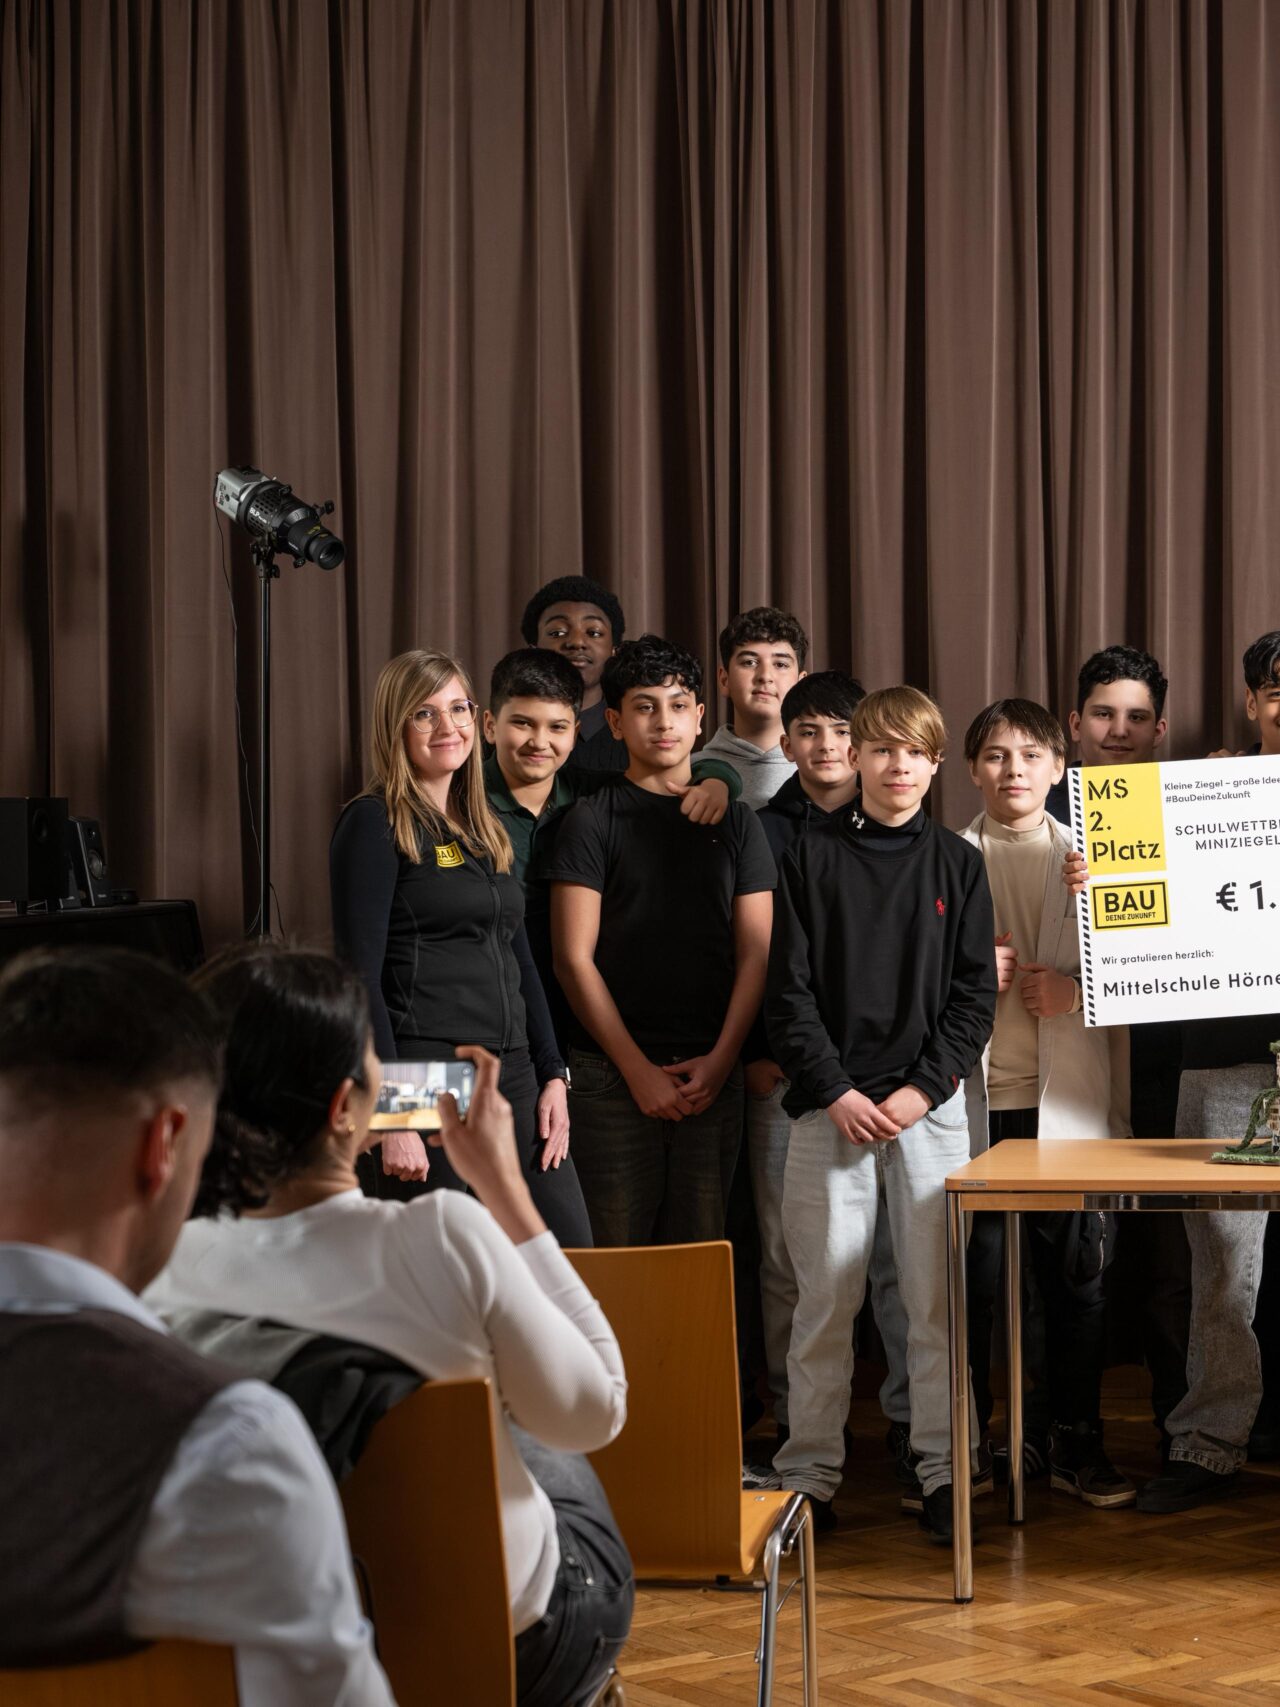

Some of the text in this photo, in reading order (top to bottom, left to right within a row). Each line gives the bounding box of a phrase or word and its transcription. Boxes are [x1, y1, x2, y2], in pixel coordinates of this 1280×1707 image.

[1088, 778, 1129, 800] MS
[1165, 782, 1193, 790] Kleine
[1195, 779, 1223, 789] Ziegel
[1233, 777, 1260, 786] große
[1165, 791, 1251, 803] #BauDeineZukunft
[1089, 810, 1112, 832] 2.
[1092, 840, 1161, 862] Platz
[1104, 890, 1155, 913] BAU
[1215, 882, 1239, 912] €
[1105, 911, 1156, 922] DEINE ZUKUNFT
[1102, 950, 1214, 965] Wir gratulieren herzlich:
[1103, 975, 1220, 997] Mittelschule
